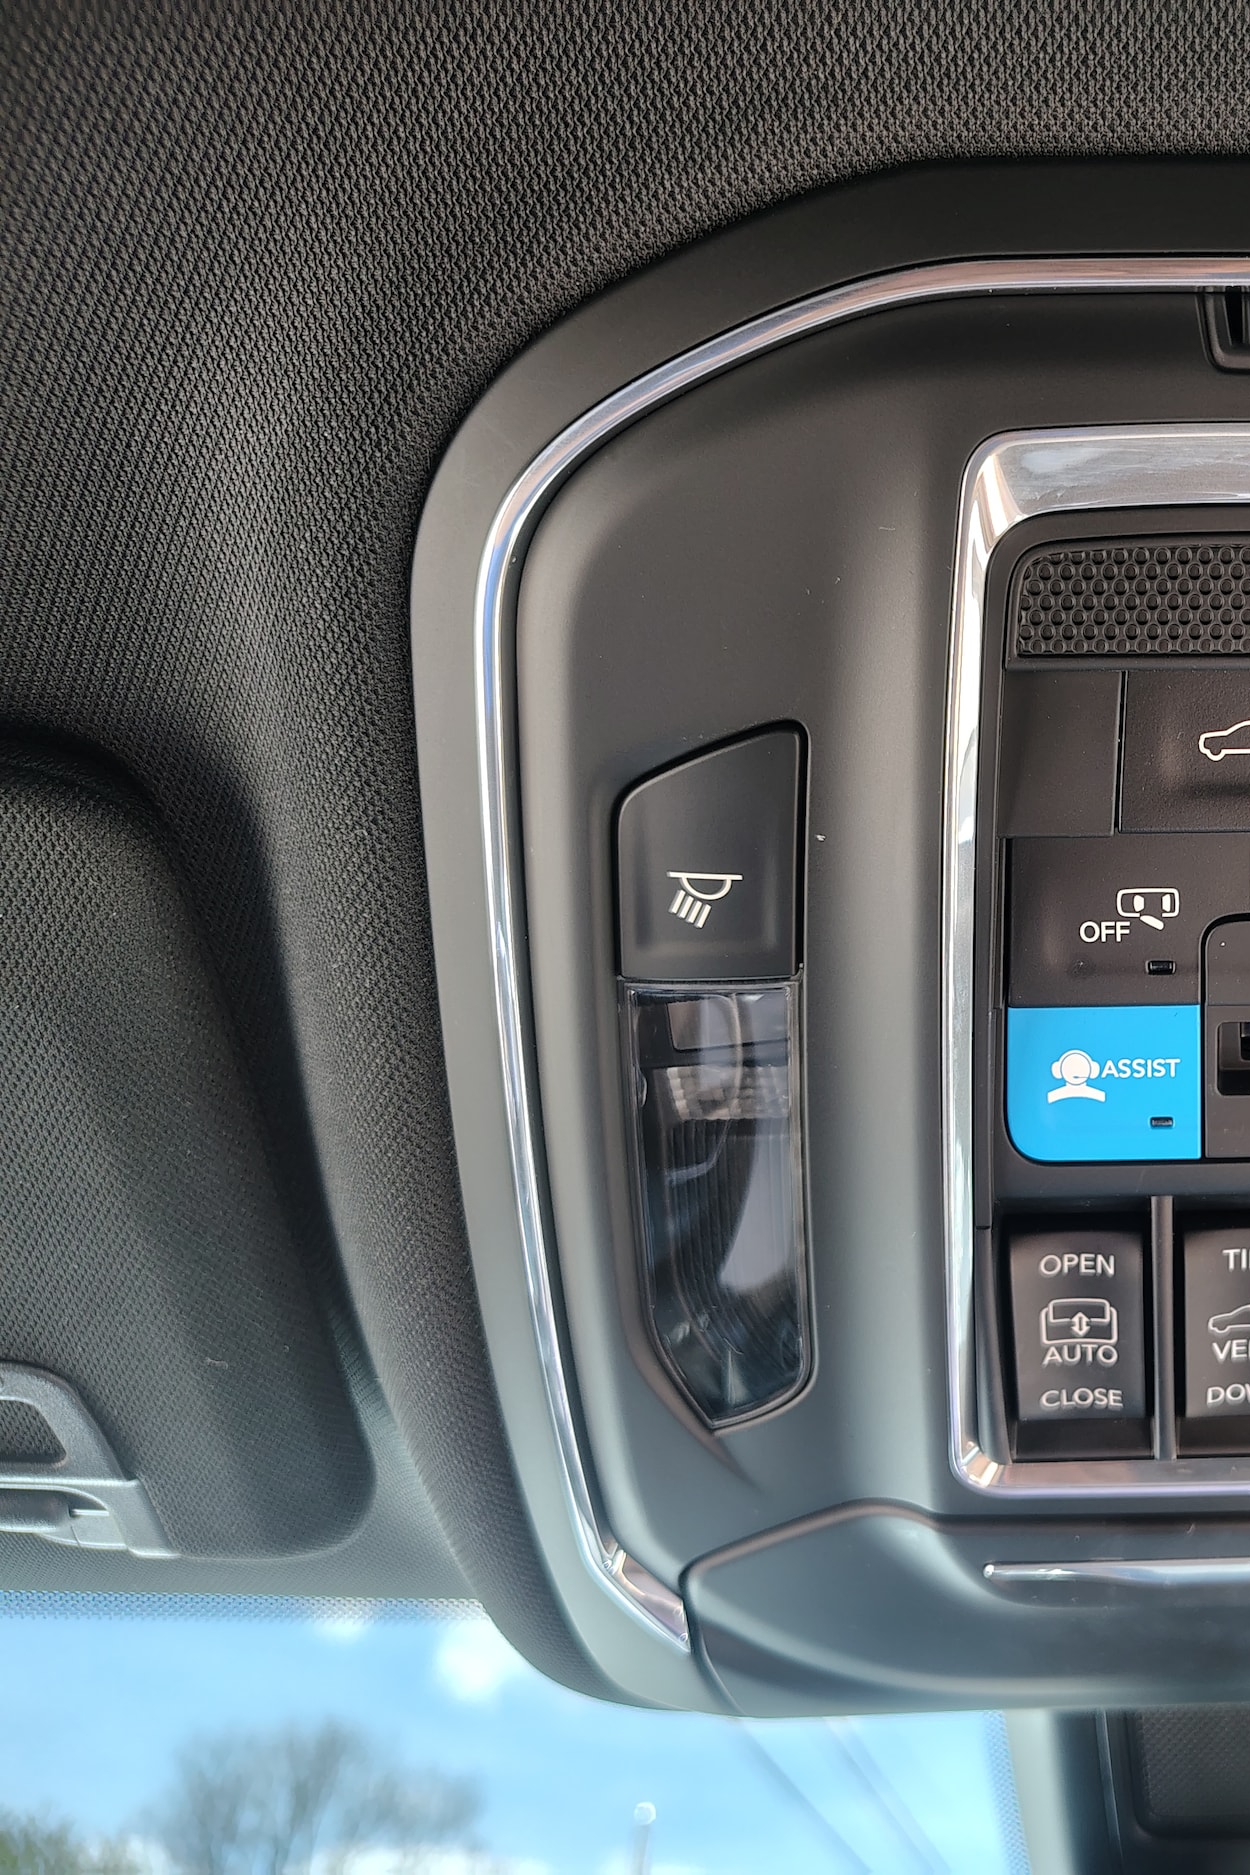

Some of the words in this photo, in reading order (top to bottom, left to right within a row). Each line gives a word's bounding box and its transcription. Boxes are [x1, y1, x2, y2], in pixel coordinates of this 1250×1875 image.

[1079, 920, 1131, 943] OFF
[1101, 1058, 1181, 1079] ASSIST
[1039, 1253, 1115, 1278] OPEN
[1043, 1344, 1118, 1368] AUTO
[1039, 1387, 1124, 1410] CLOSE
